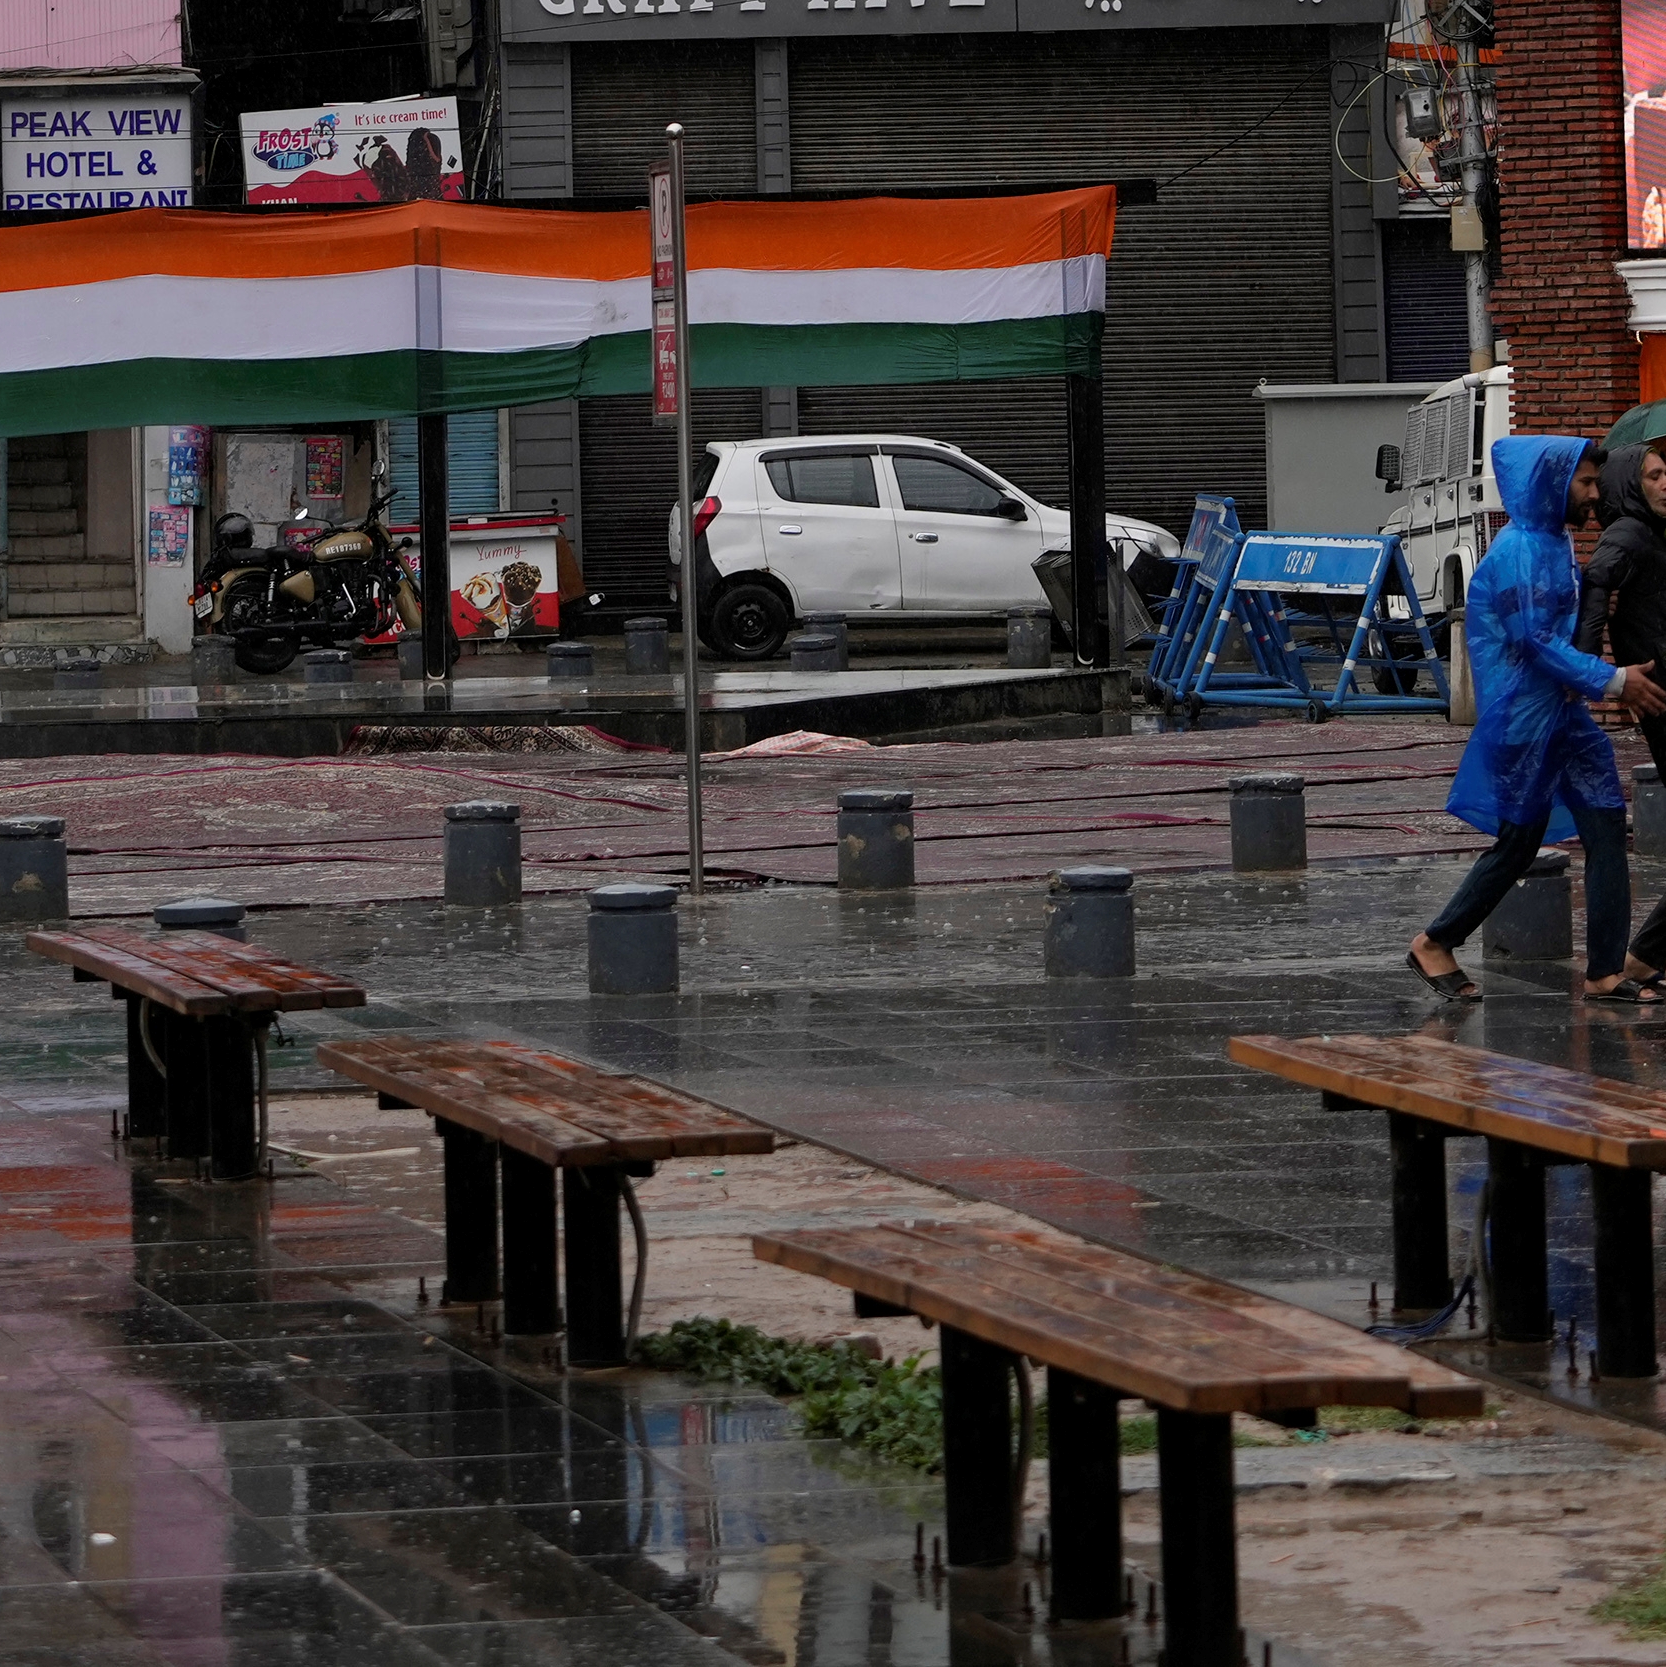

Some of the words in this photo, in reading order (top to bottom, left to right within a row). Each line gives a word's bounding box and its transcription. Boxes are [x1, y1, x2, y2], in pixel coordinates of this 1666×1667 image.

[11, 111, 92, 137] PEAK
[108, 109, 182, 135] VIEW
[355, 114, 370, 126] It's
[373, 114, 386, 124] ice
[389, 112, 418, 124] cream
[421, 109, 447, 121] time!
[257, 127, 312, 153] FROST
[26, 151, 123, 178] HOTEL
[137, 149, 157, 175] &
[275, 151, 305, 170] TIME
[6, 190, 188, 211] RESTAURANT
[476, 544, 527, 561] Yummy
[1284, 551, 1302, 574] 132
[1300, 551, 1318, 574] BN
